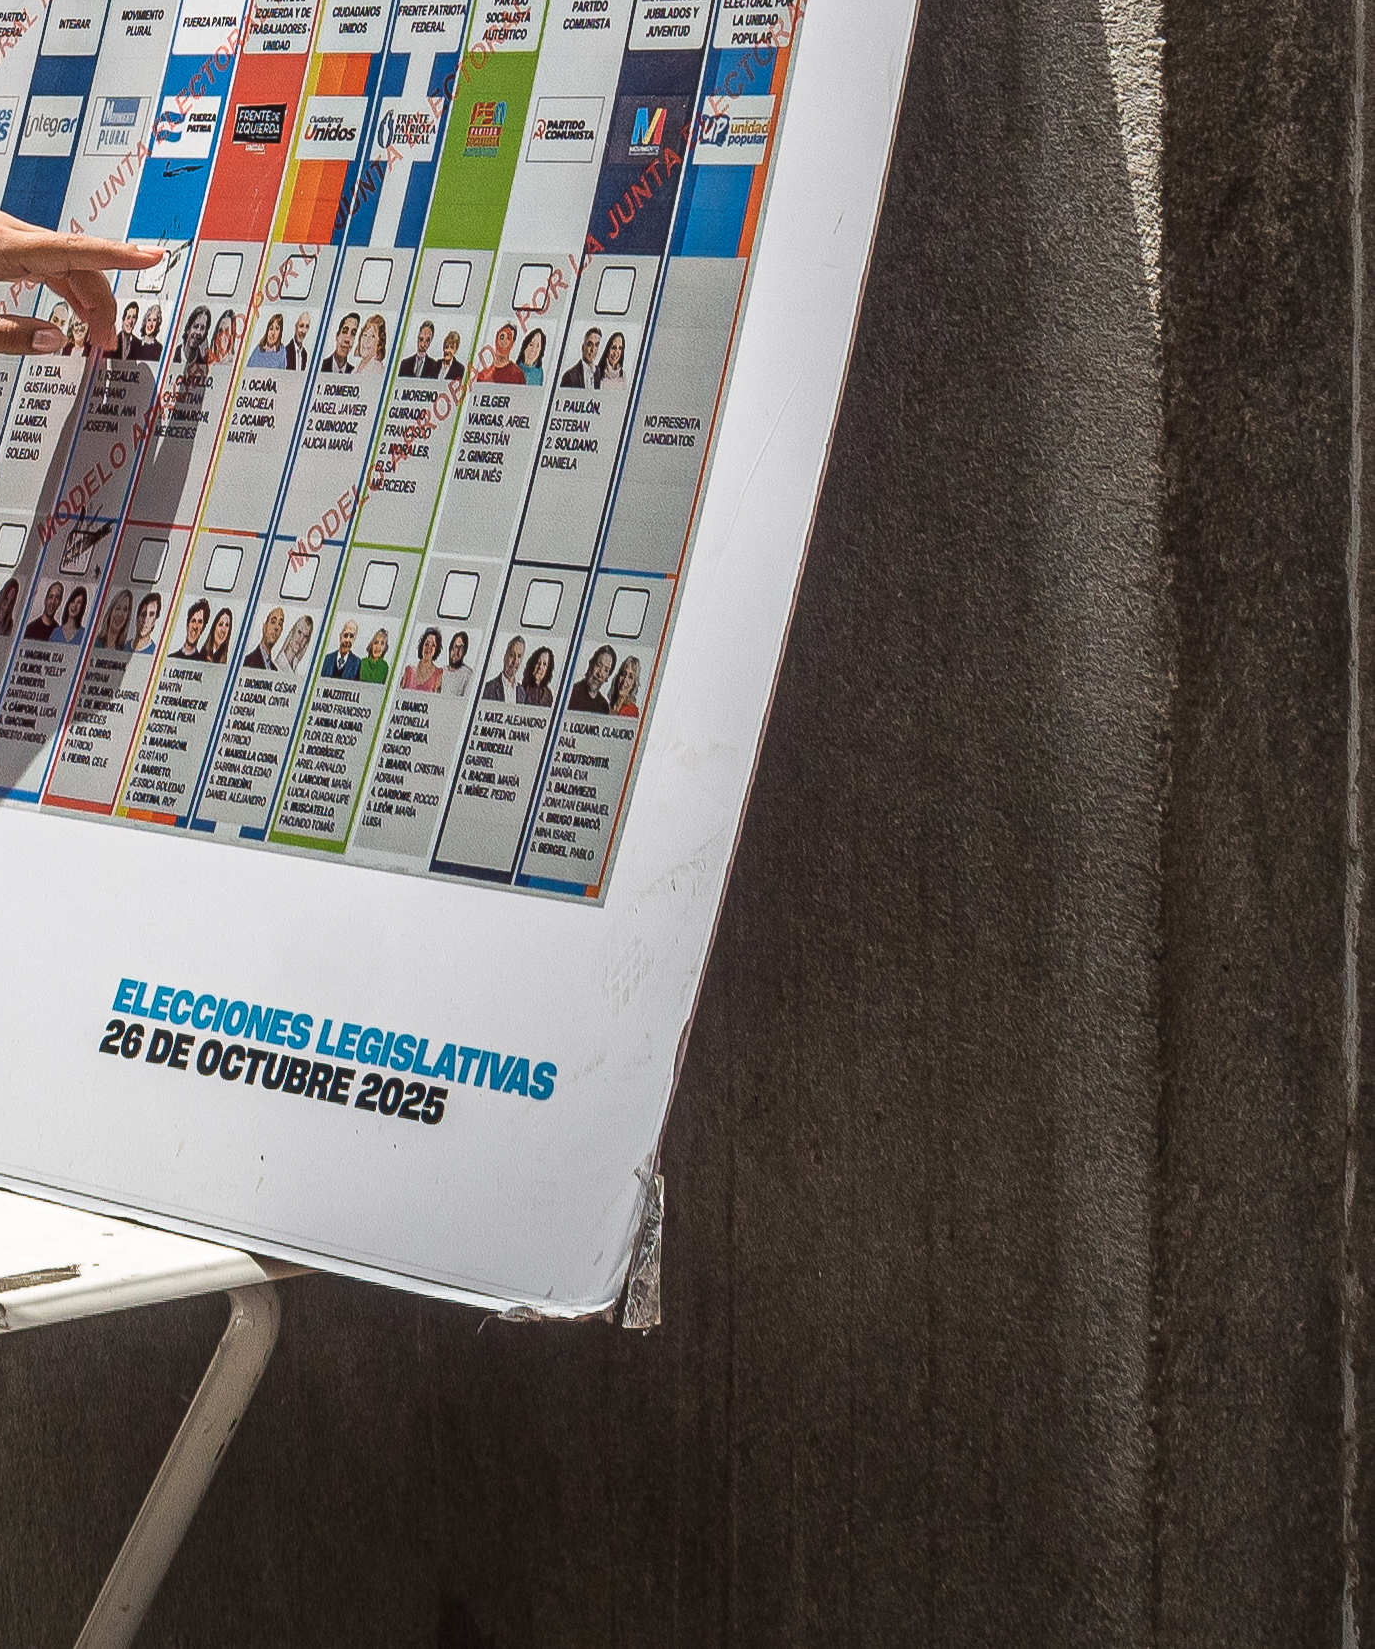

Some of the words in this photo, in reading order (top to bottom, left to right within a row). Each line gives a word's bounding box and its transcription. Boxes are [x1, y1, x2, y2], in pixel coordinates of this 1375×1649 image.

[332, 5, 381, 18] CIUDADANOS
[398, 4, 428, 17] FRENTE
[428, 4, 467, 17] PATRIOTA
[572, 0, 609, 13] PARTIDO
[644, 6, 692, 20] JUBILADOS
[182, 16, 210, 28] FUERZA
[211, 16, 238, 28] PATRIA
[485, 11, 531, 24] SOCIALISTA
[562, 17, 611, 31] COMUNISTA
[744, 13, 779, 27] UNIDAD
[125, 25, 152, 37] PLURAL
[410, 20, 446, 34] FEDERAL
[645, 25, 691, 38] JUVENTUD
[731, 31, 772, 45] POPULAR
[188, 112, 217, 124] FUERZA
[239, 110, 272, 123] FRENTE
[396, 113, 431, 125] FRENTE
[24, 113, 77, 139] integrar
[235, 122, 280, 135] IZQUIERDA
[394, 123, 437, 135] PATRIOTA
[546, 119, 586, 131] PARTIDO
[730, 120, 769, 134] unidad
[99, 129, 129, 146] PLURAL
[304, 123, 356, 142] Unidos
[392, 133, 431, 145] FEDERAL
[544, 129, 595, 141] COMUNISTA
[88, 139, 152, 224] JUNTA
[607, 148, 682, 240] JUNTA
[236, 396, 274, 410] GRACIELA
[479, 395, 511, 409] ELGER
[338, 403, 368, 417] JAVIER
[505, 416, 531, 429] ARIEL
[549, 418, 591, 433] ESTEBAN
[644, 415, 658, 428] NO
[658, 416, 701, 430] PRESENTA
[227, 430, 258, 444] MARTÍN
[462, 431, 511, 446] SEBASTIÁN
[642, 434, 696, 447] CANDIDATOS
[540, 455, 578, 470] DANIELA
[36, 442, 129, 547] MODELO
[112, 978, 313, 1049] ELECCIONES
[315, 1018, 558, 1102] LEGISLATIVAS
[99, 1017, 146, 1060] 26
[145, 1027, 196, 1071] DE
[196, 1037, 356, 1106] OCTUBRE
[354, 1072, 450, 1126] 2025
